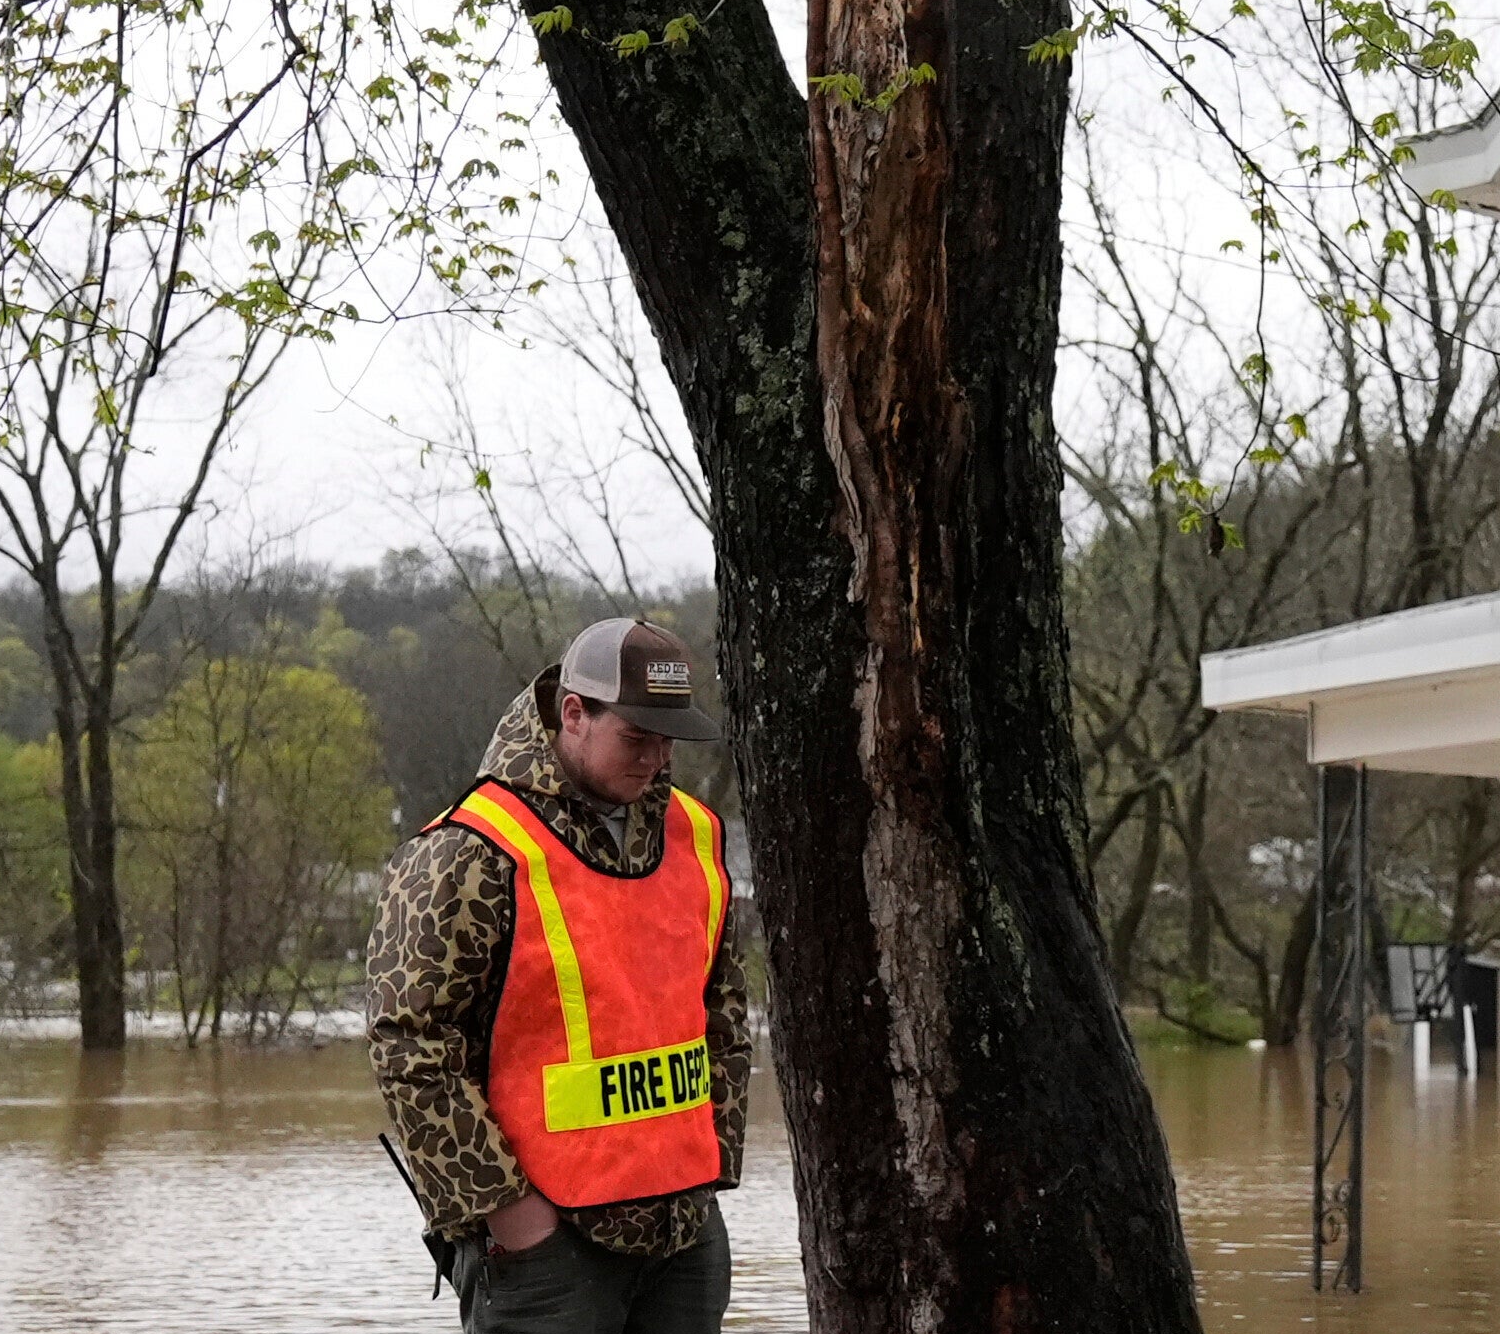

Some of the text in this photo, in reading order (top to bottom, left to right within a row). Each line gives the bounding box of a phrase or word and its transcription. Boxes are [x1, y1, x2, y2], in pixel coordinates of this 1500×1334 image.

[648, 663, 671, 674] RED
[600, 1044, 709, 1117] FIRE DEPT.
